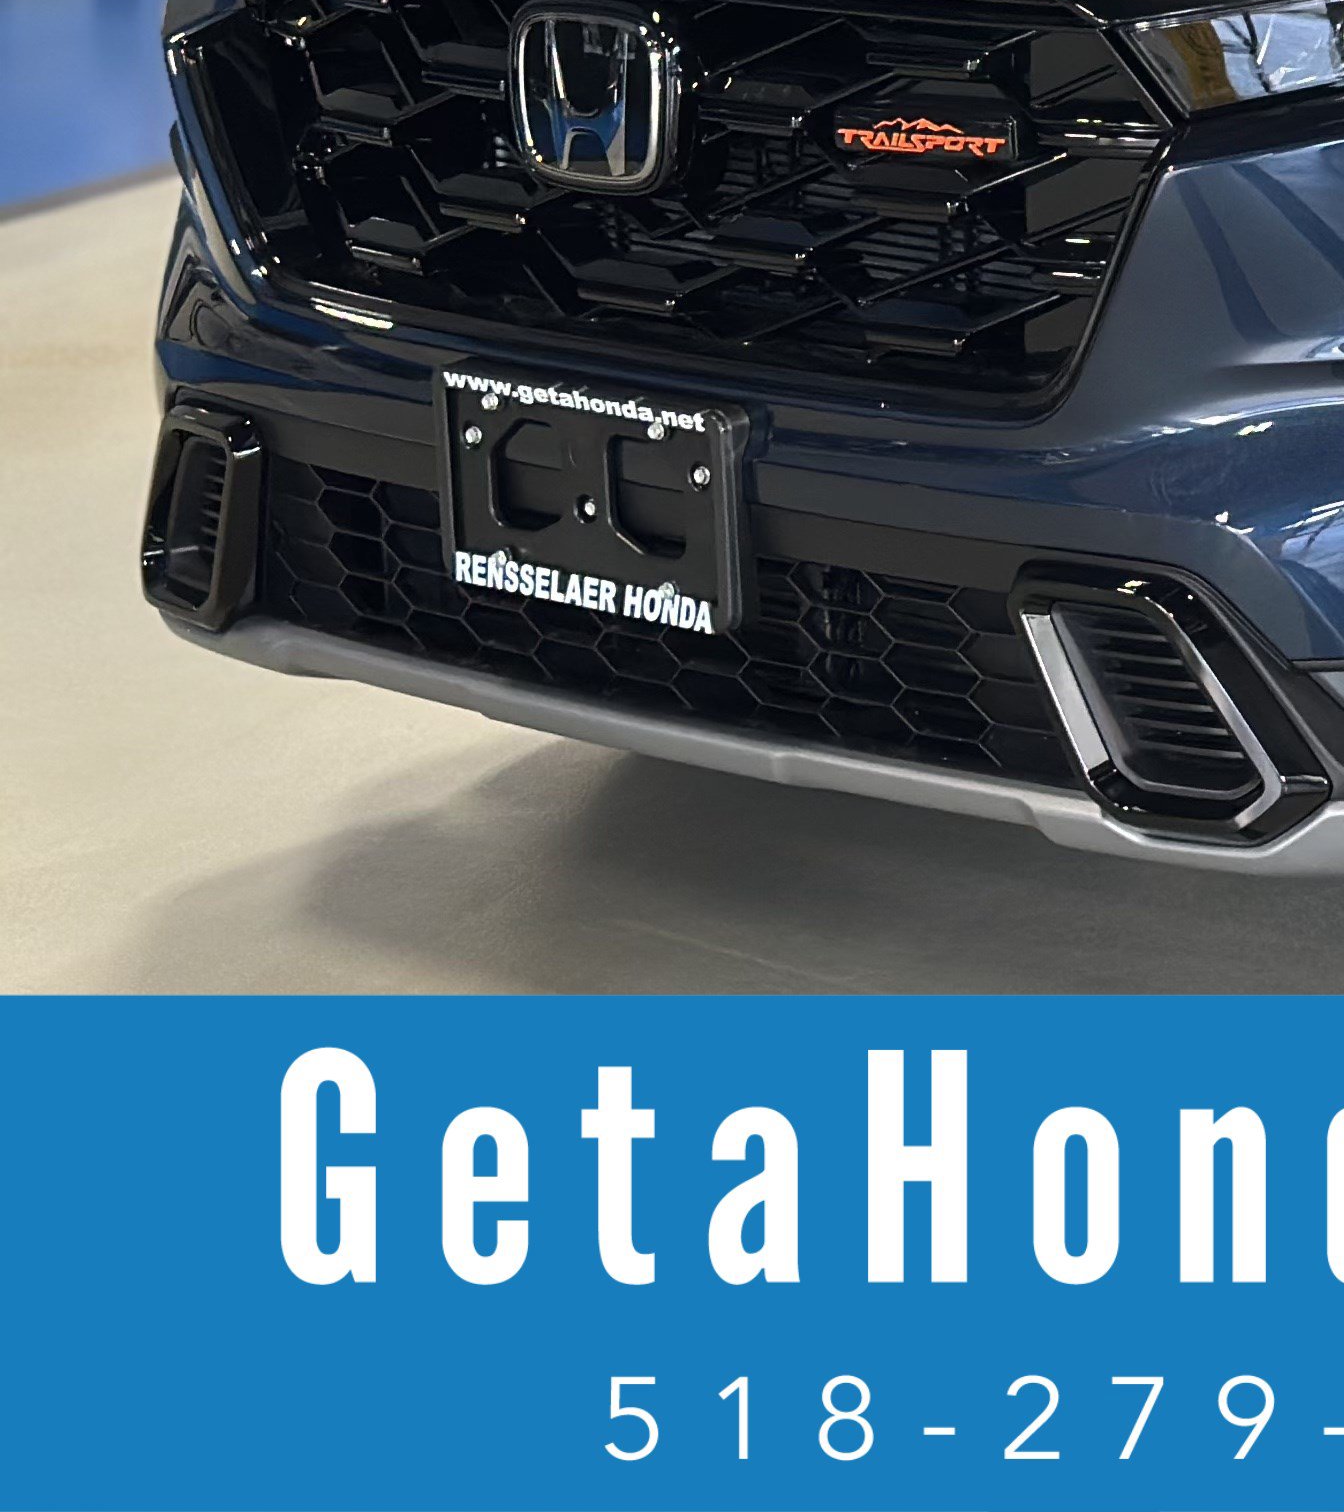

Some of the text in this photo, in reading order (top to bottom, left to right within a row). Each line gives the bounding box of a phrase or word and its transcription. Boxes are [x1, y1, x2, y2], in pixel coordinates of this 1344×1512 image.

[838, 128, 1005, 158] TRAILSPORT
[443, 371, 706, 434] www.getahonda.net
[455, 550, 714, 635] RENSSELAER HONDA
